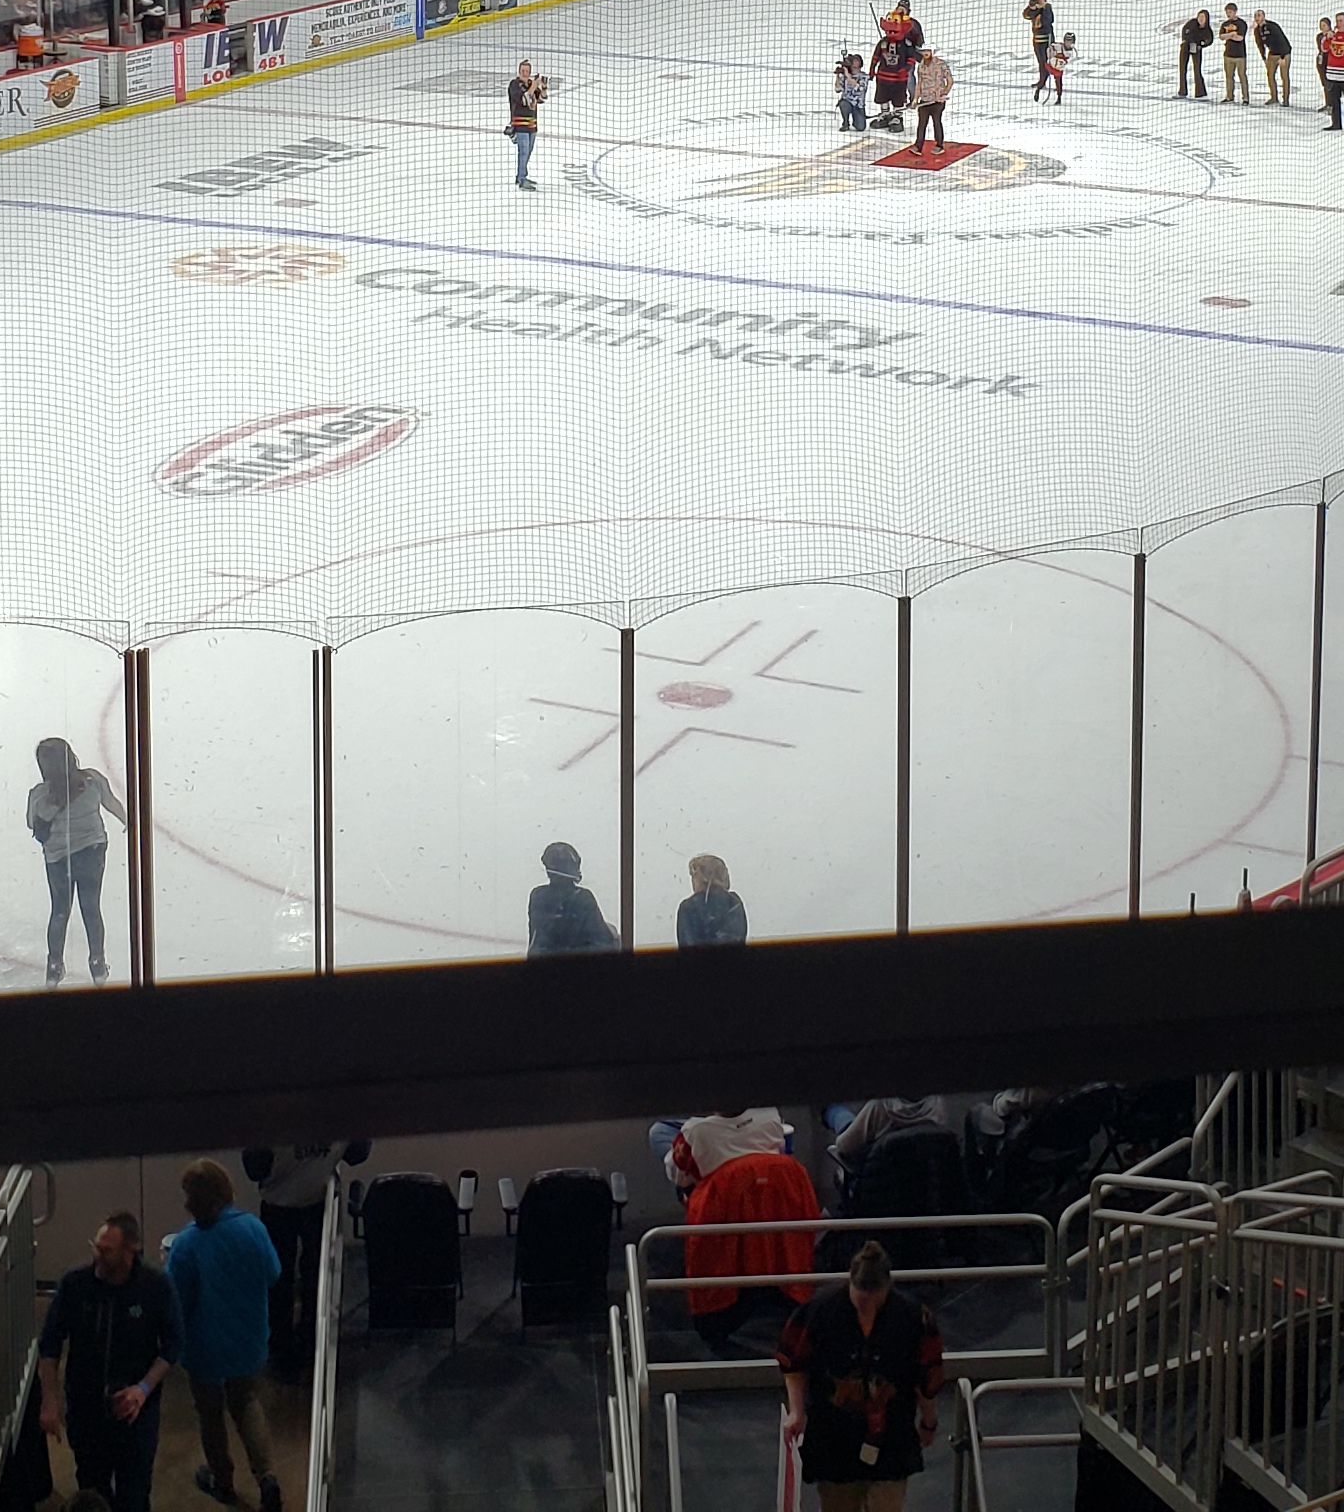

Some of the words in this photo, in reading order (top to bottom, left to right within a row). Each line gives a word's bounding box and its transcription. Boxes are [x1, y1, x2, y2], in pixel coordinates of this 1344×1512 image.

[382, 7, 393, 17] AND
[258, 53, 285, 71] 481
[357, 266, 922, 351] Community
[410, 303, 663, 357] Health
[676, 338, 1045, 399] Network
[171, 403, 405, 498] Glidden
